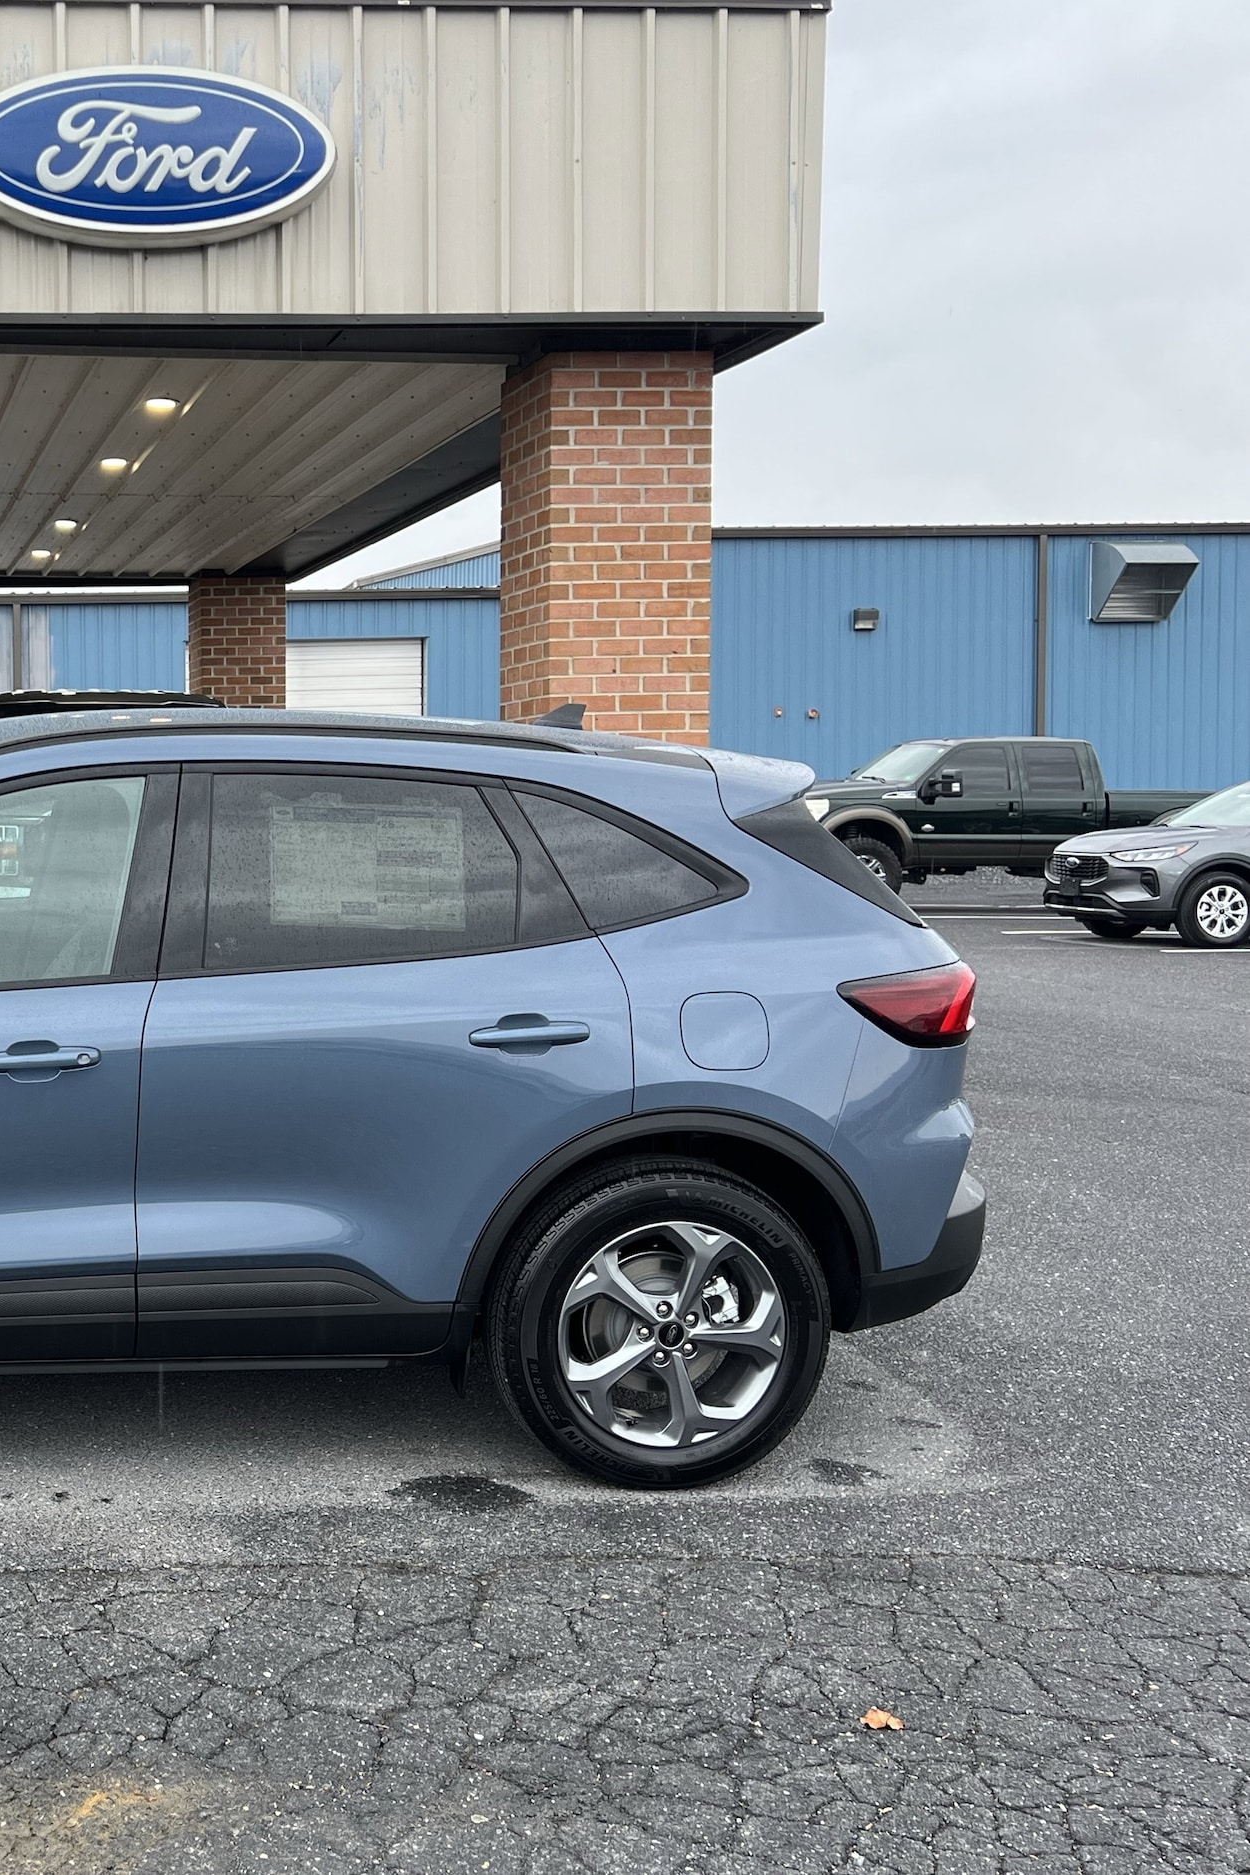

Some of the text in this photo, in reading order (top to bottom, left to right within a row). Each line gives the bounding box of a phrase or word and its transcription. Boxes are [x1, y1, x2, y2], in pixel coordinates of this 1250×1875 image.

[35, 99, 258, 194] Ford
[707, 1198, 782, 1245] MICHELIN
[789, 1253, 815, 1296] PRIMACY
[536, 1387, 559, 1421] 225/60
